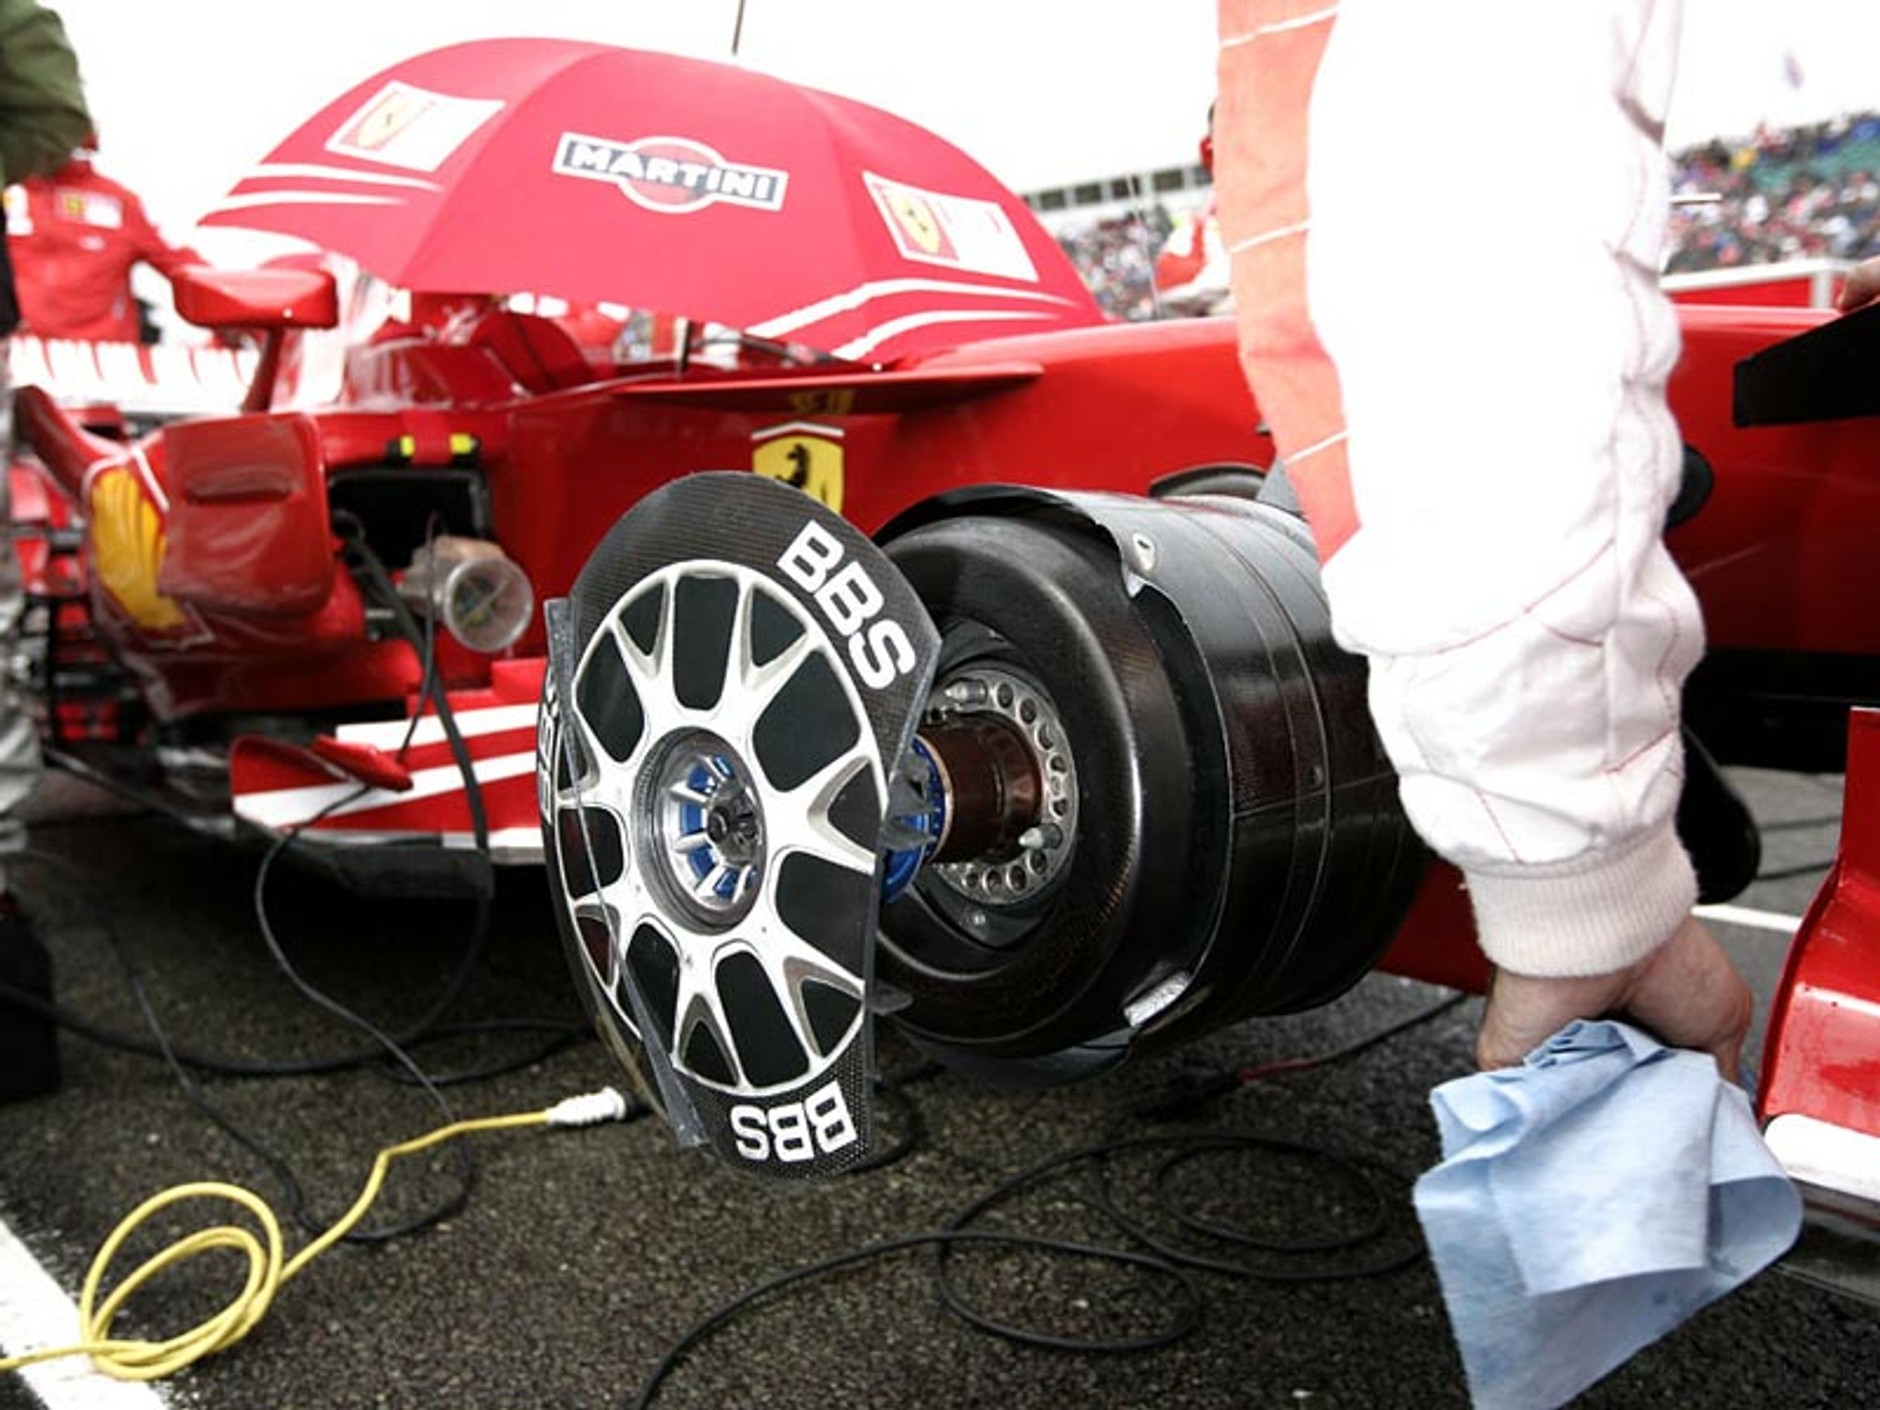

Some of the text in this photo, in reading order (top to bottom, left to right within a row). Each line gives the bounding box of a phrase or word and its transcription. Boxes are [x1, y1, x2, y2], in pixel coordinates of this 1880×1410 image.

[569, 143, 773, 200] MARTINI
[776, 519, 916, 690] BBS
[730, 1080, 858, 1162] BBS
